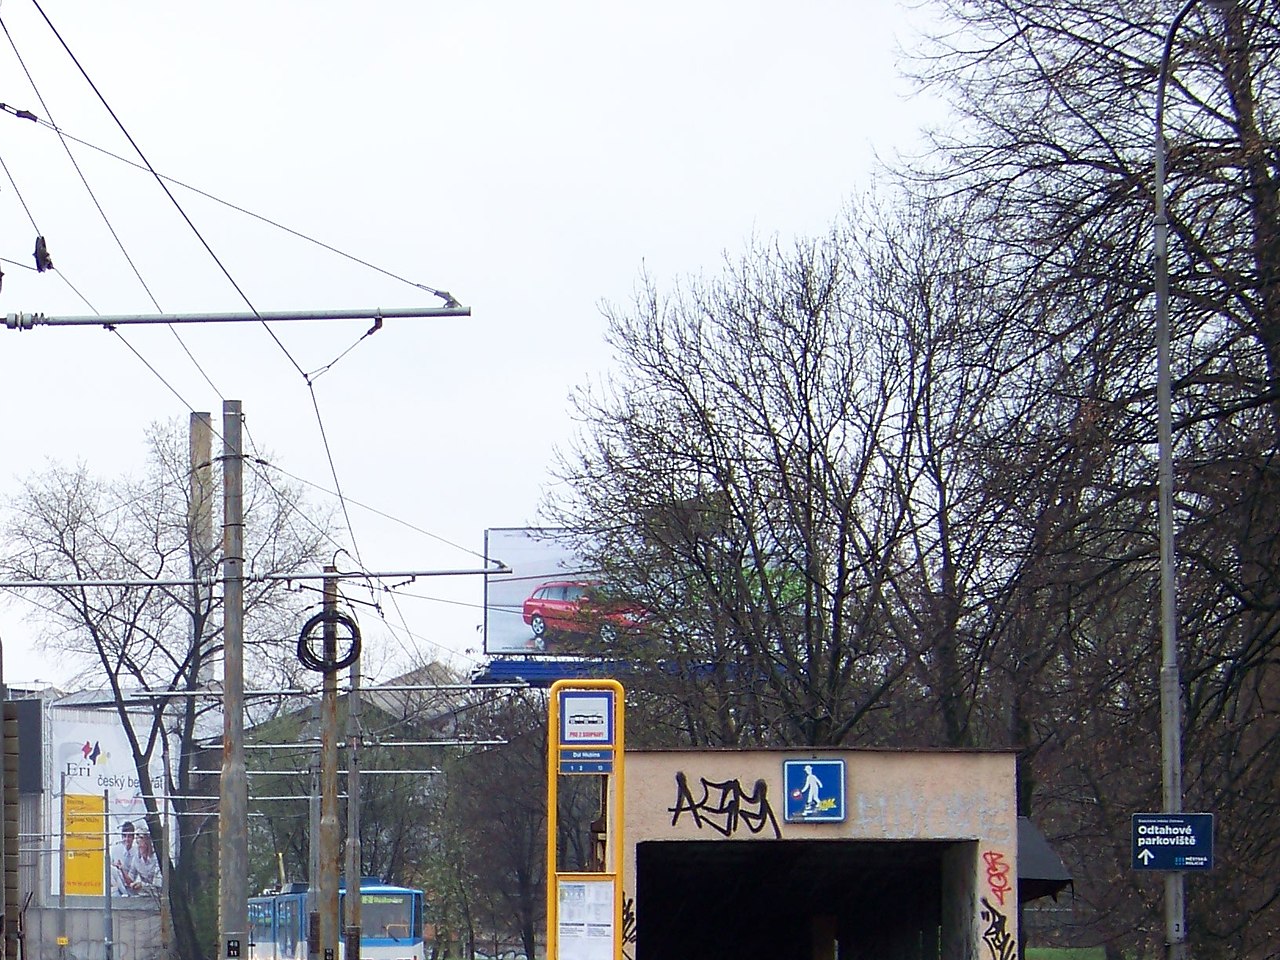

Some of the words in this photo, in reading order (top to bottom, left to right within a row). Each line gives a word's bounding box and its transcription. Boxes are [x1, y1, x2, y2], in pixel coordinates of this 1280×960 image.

[65, 763, 91, 777] Eri
[97, 774, 126, 790] český
[1138, 825, 1192, 834] Odtahové
[1137, 836, 1196, 847] parkoviště
